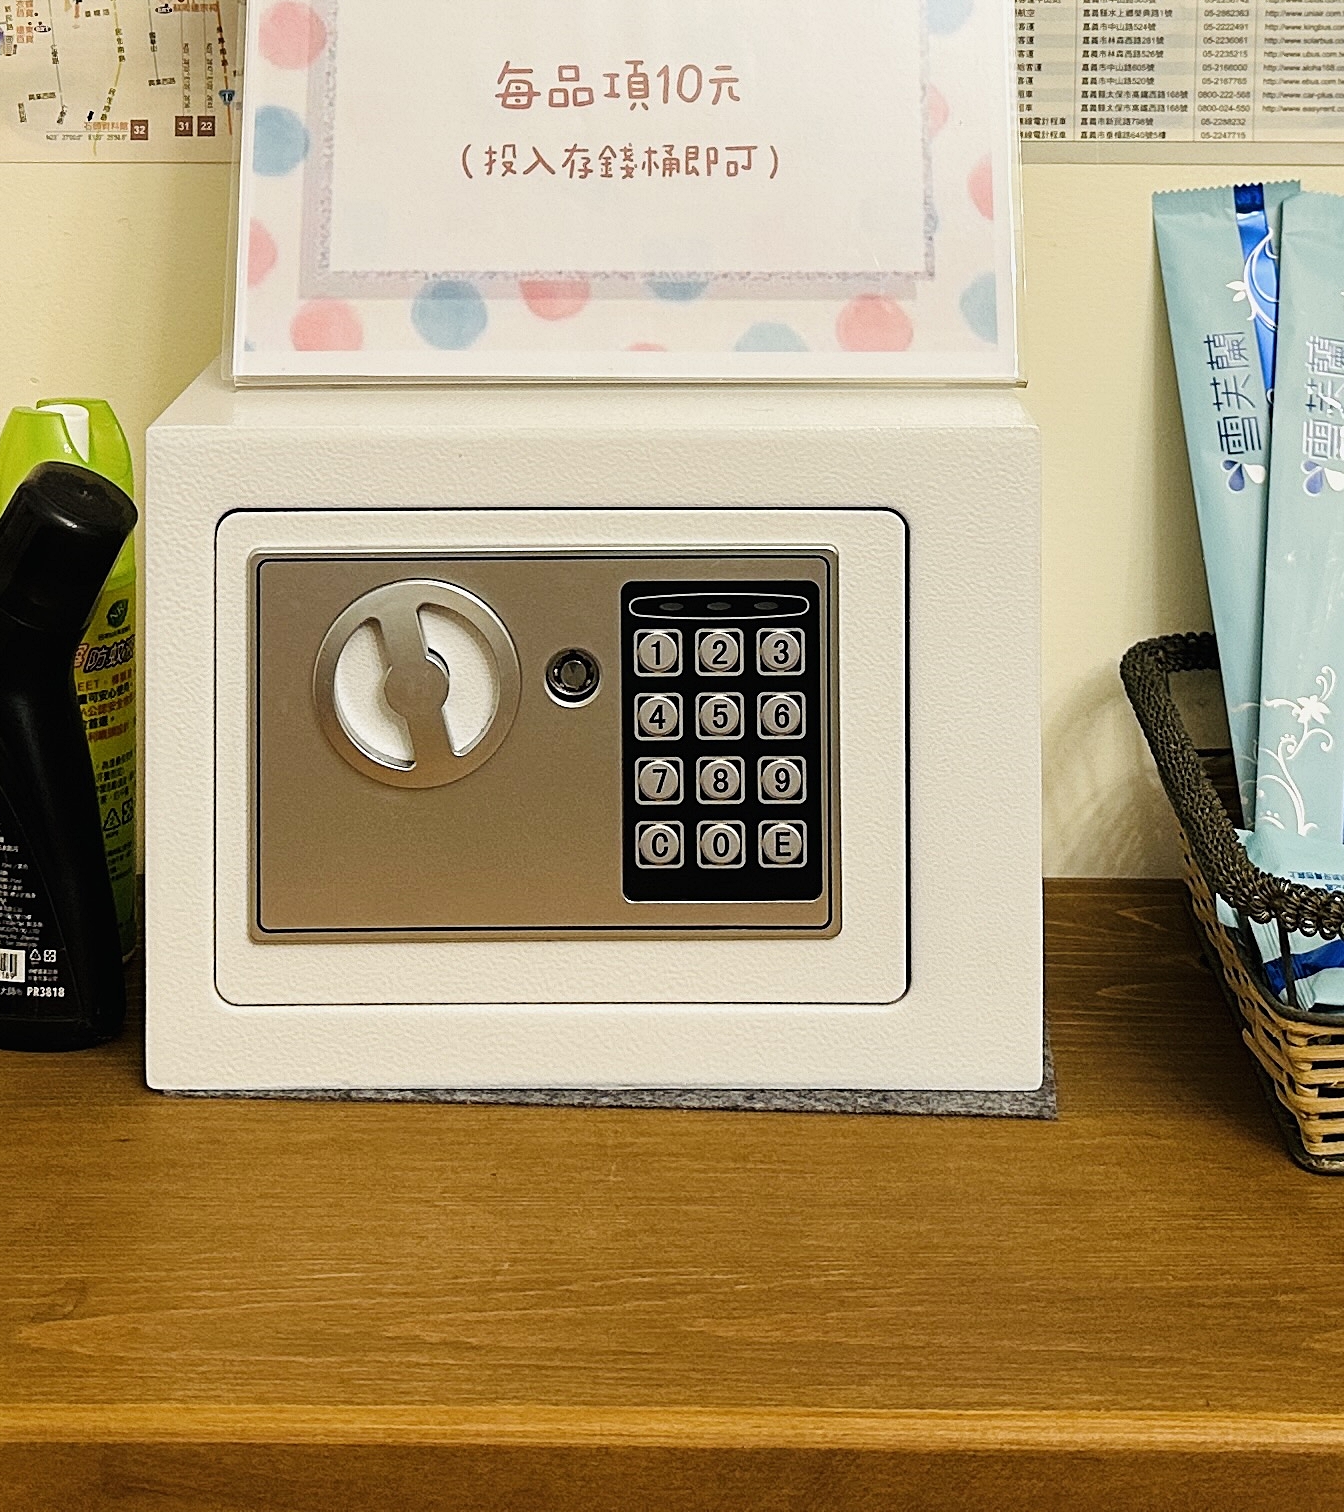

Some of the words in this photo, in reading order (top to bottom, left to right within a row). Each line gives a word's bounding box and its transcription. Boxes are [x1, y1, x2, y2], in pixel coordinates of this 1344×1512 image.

[495, 60, 740, 111] 每品項10元
[460, 142, 780, 180] （投入存錢桶即可）
[1204, 331, 1263, 455] 雪芙蘭
[650, 642, 662, 664] 1
[712, 641, 728, 665] 2
[773, 641, 790, 665] 3
[648, 704, 666, 728] 4
[712, 704, 728, 728] 5
[774, 704, 790, 728] 6
[652, 769, 668, 794] 7
[712, 769, 730, 794] 8
[774, 769, 791, 794] 9
[651, 832, 669, 858] C
[714, 832, 730, 858] 0
[775, 832, 791, 858] E
[26, 987, 65, 997] PR3818
